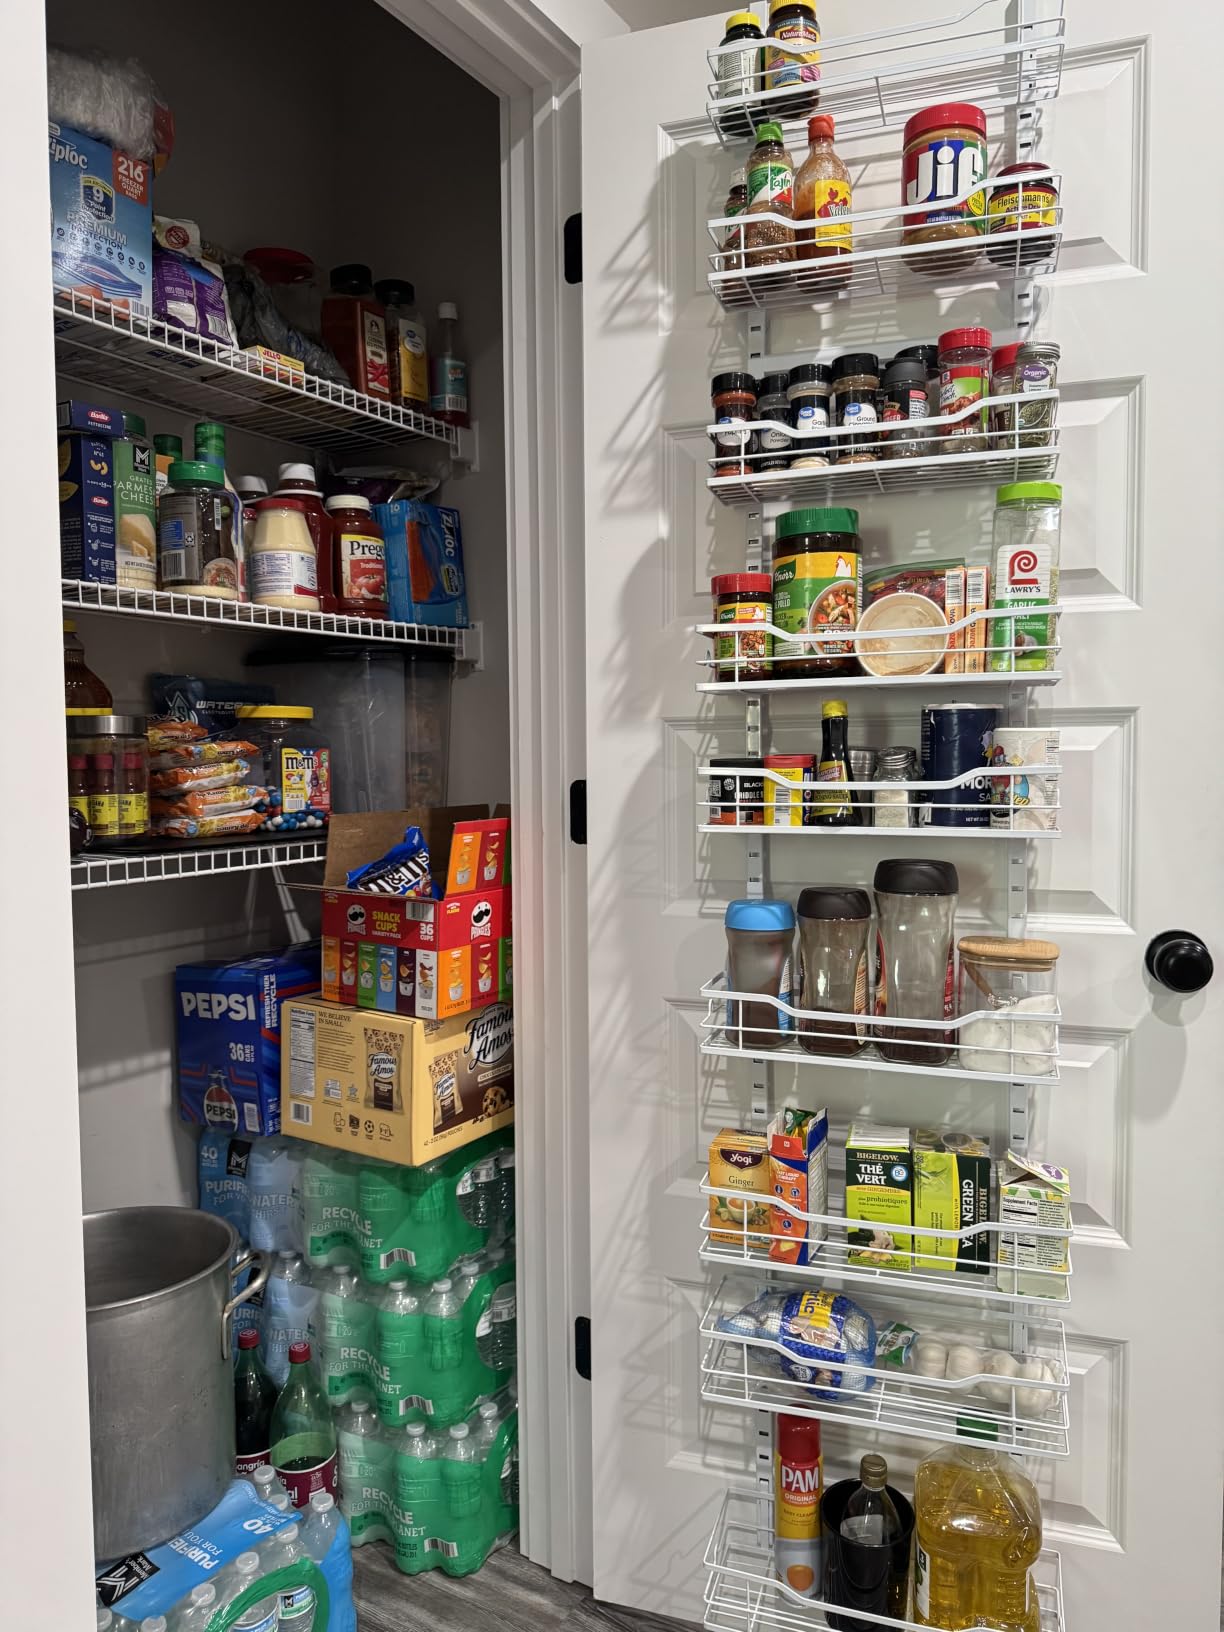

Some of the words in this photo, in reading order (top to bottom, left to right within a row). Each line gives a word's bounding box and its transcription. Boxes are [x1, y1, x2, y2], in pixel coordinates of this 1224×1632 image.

[117, 155, 144, 183] 216
[906, 146, 984, 205] Jif
[118, 174, 144, 193] FREEZER
[121, 182, 142, 197] QUART
[92, 186, 105, 203] 9
[66, 211, 128, 245] PREMIUM
[1023, 369, 1047, 377] Organic
[371, 911, 401, 921] SNACK
[375, 921, 398, 933] CUPS
[420, 923, 434, 936] 36
[180, 991, 256, 1021] PEPSI
[270, 974, 278, 1028] RECYCLE
[328, 1013, 352, 1022] BELIEVE
[463, 1007, 514, 1055] Famou
[229, 1042, 244, 1062] 36
[368, 1053, 397, 1068] Famous
[370, 1065, 394, 1076] Amos
[206, 1102, 237, 1120] PEPSI
[201, 1146, 218, 1160] 40
[859, 1163, 884, 1175] THÉ
[728, 1175, 755, 1187] Ginger
[856, 1173, 887, 1185] VERT
[962, 1179, 974, 1222] GREEN
[322, 1207, 372, 1235] RECYCLE
[979, 1187, 988, 1244] BIGELW
[311, 1221, 330, 1232] FOR
[329, 1361, 348, 1372] FOR
[340, 1347, 391, 1381] RECYCLE
[781, 1464, 819, 1493] PAM
[784, 1493, 817, 1501] ORIGINAL
[351, 1500, 370, 1512] FOR
[362, 1487, 414, 1525] RECYCLE
[243, 1519, 273, 1535] 40
[202, 1540, 223, 1557] FOR
[125, 1557, 149, 1581] Member's
[137, 1555, 153, 1571] Mark
